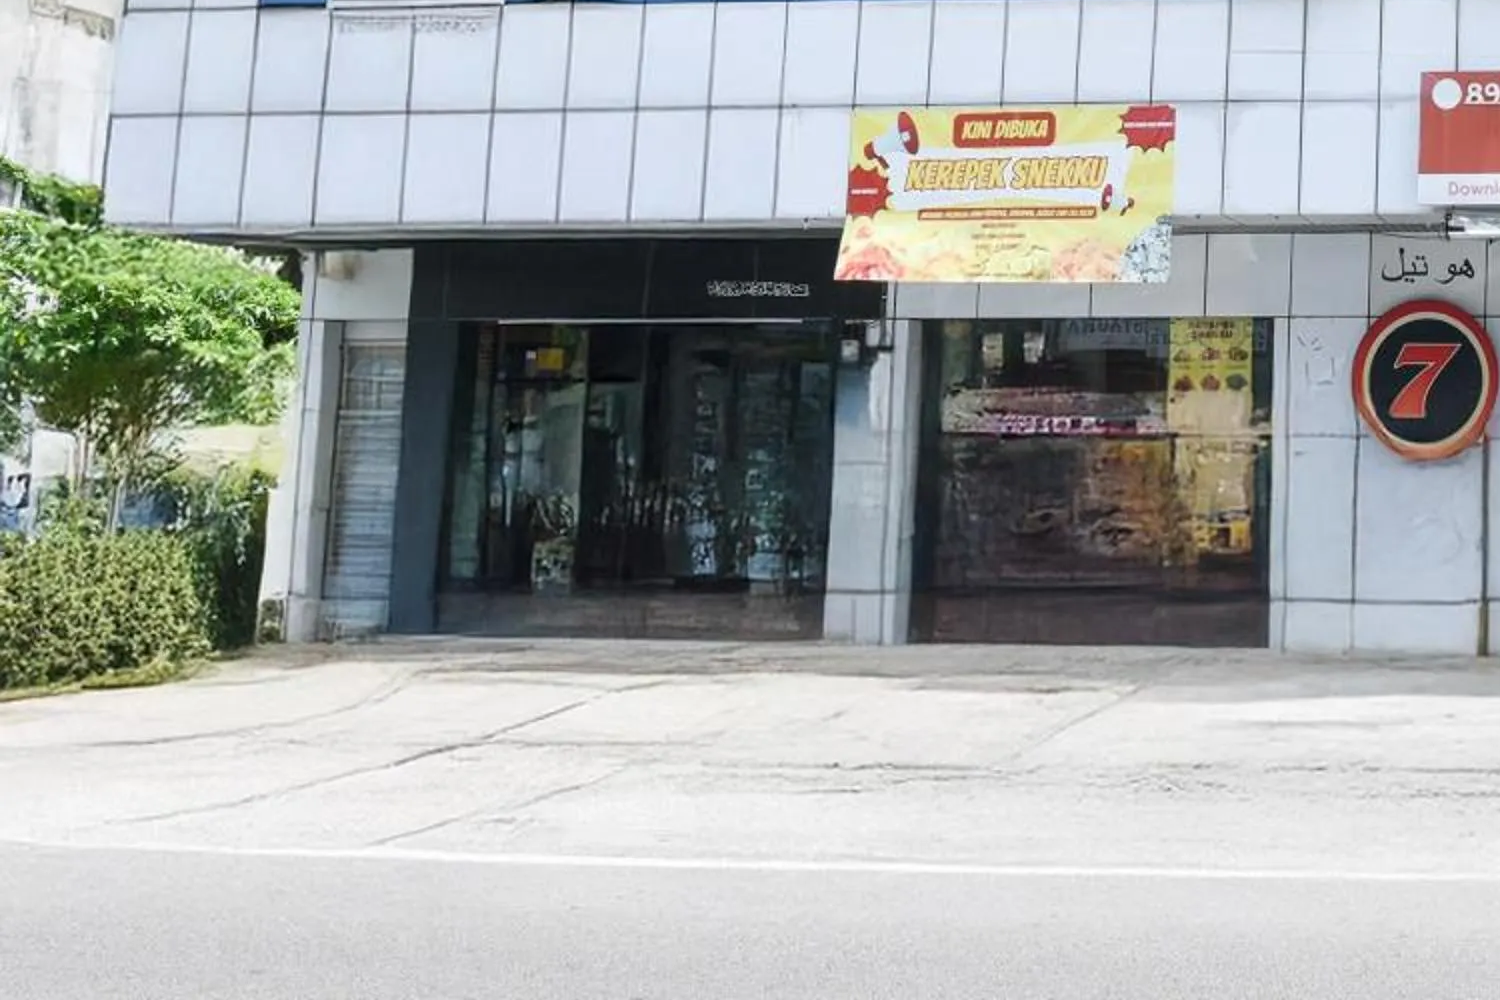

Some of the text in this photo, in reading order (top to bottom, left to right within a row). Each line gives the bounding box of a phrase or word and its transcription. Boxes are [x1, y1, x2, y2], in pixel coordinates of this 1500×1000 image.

[961, 119, 1049, 141] KINI DIBUKA
[904, 155, 1108, 192] KEREPEK SNEKKU
[1389, 343, 1462, 419] 7
